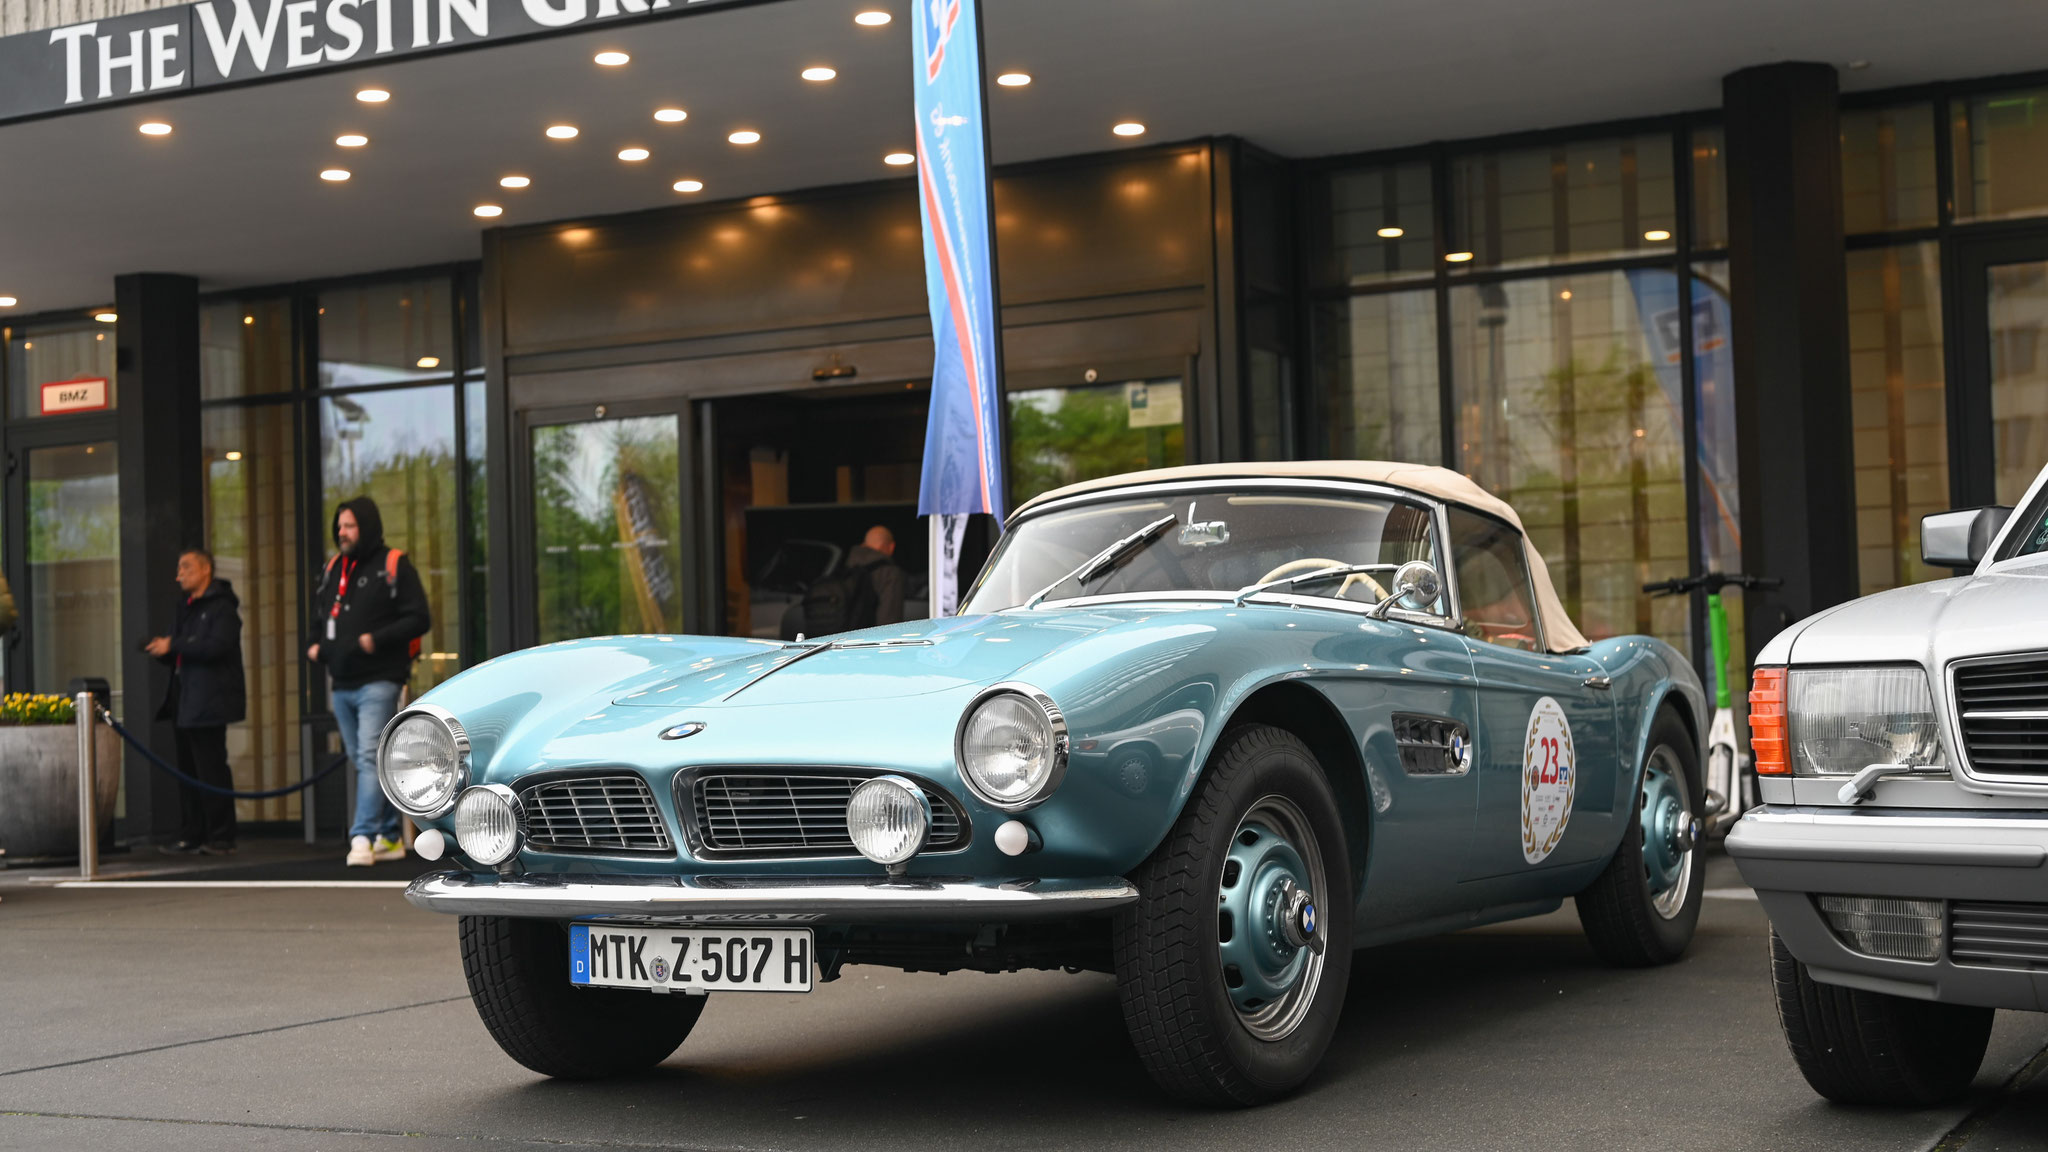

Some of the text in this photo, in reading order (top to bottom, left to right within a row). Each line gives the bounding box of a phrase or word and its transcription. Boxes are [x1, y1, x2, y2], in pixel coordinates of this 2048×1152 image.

[59, 389, 88, 403] BMZ
[1540, 736, 1559, 785] 23
[576, 960, 584, 973] D
[590, 933, 649, 981] MTK
[784, 938, 807, 984] H
